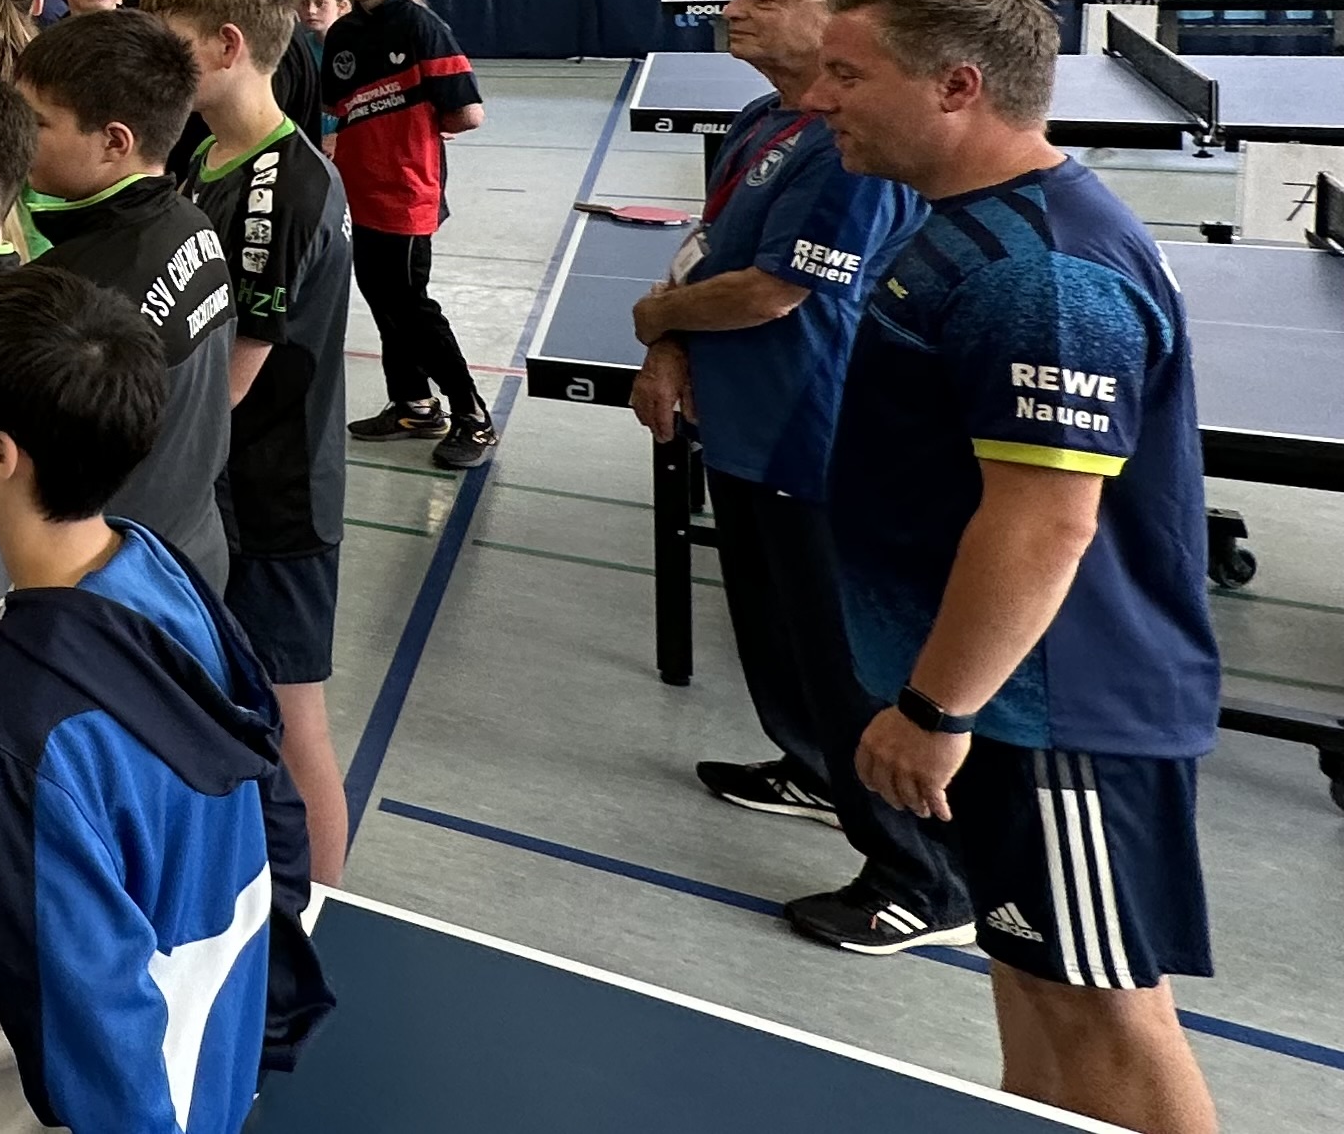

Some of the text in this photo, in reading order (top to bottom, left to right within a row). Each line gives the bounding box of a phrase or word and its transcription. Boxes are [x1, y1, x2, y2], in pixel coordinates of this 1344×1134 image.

[692, 123, 732, 134] ROLL
[790, 254, 853, 285] Nauen
[793, 239, 862, 272] REWE
[140, 276, 176, 327] TSV
[1011, 362, 1117, 403] REWE
[1016, 396, 1110, 433] Nauen
[985, 915, 1045, 943] adidas
